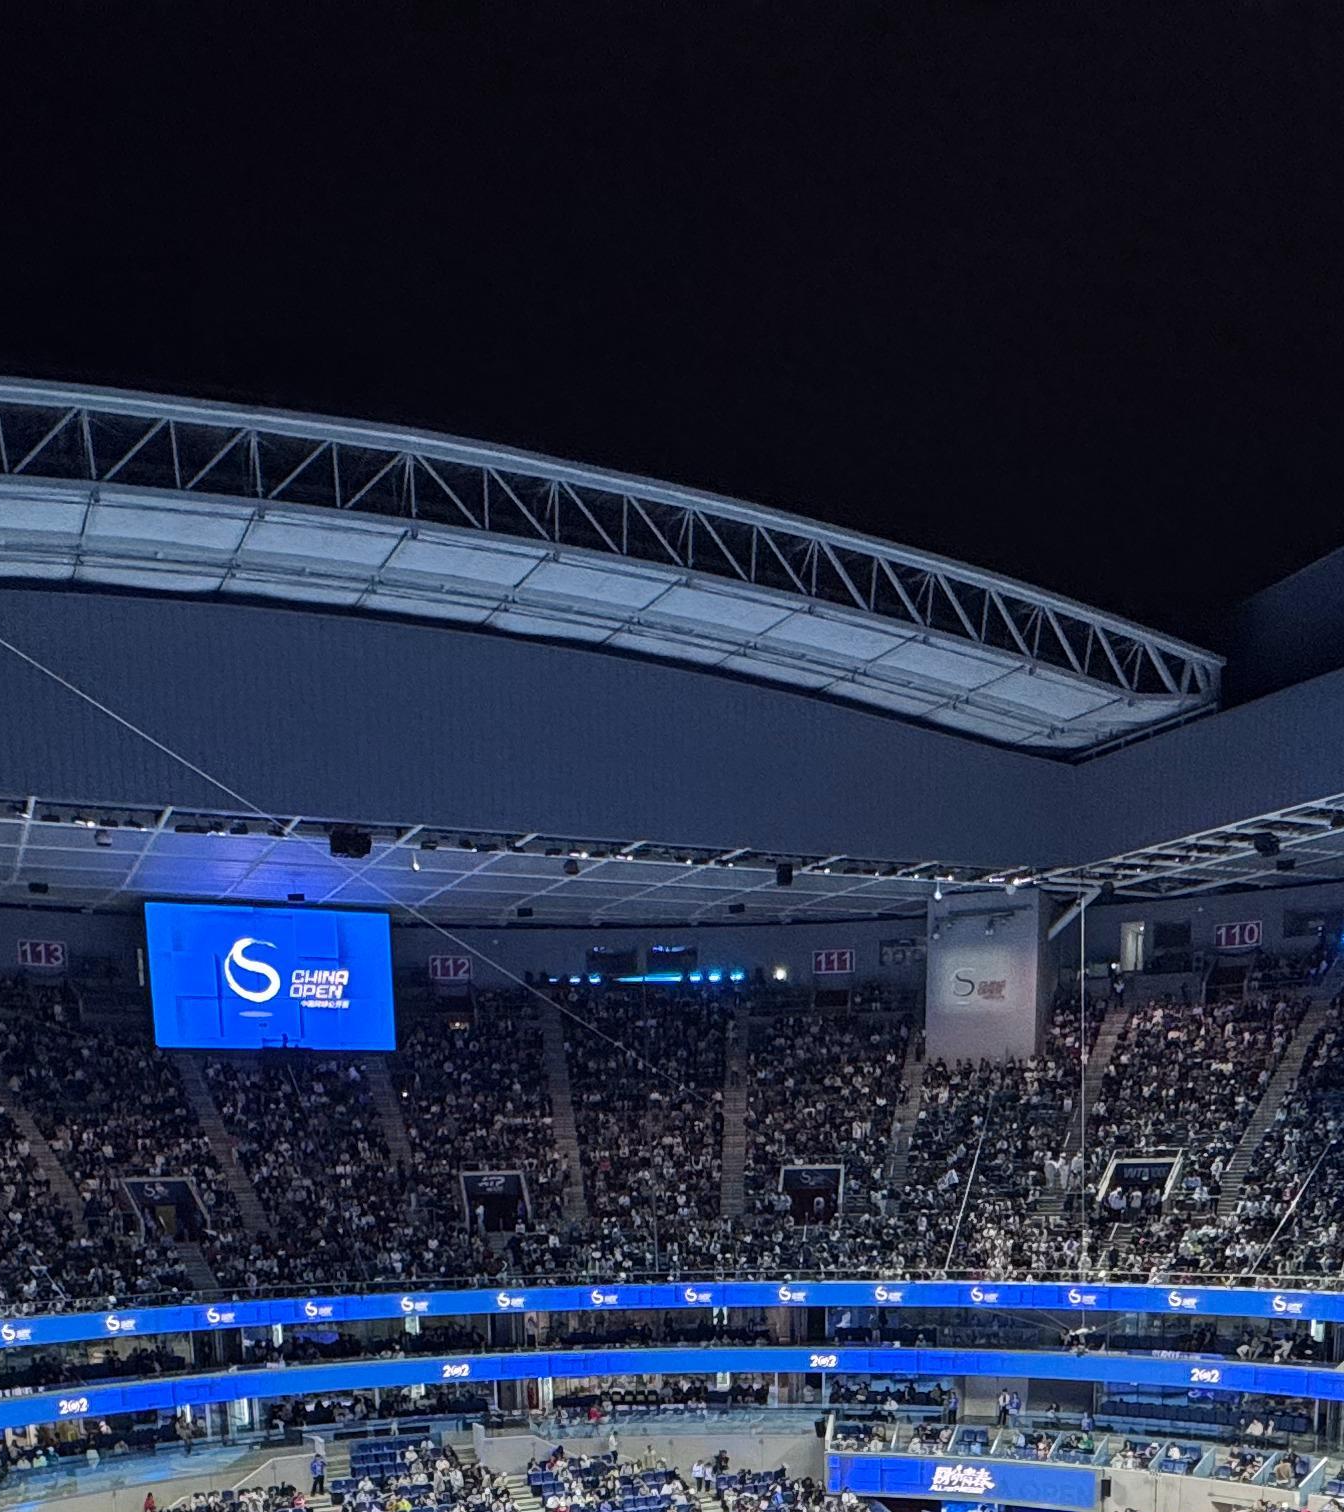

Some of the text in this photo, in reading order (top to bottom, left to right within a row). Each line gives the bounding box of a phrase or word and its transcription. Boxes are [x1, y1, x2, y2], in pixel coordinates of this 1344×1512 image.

[1216, 922, 1259, 946] 110
[21, 942, 64, 966] 113
[815, 951, 852, 973] 111
[291, 969, 350, 986] CHINA
[431, 957, 470, 978] 112
[289, 984, 345, 999] OPEN
